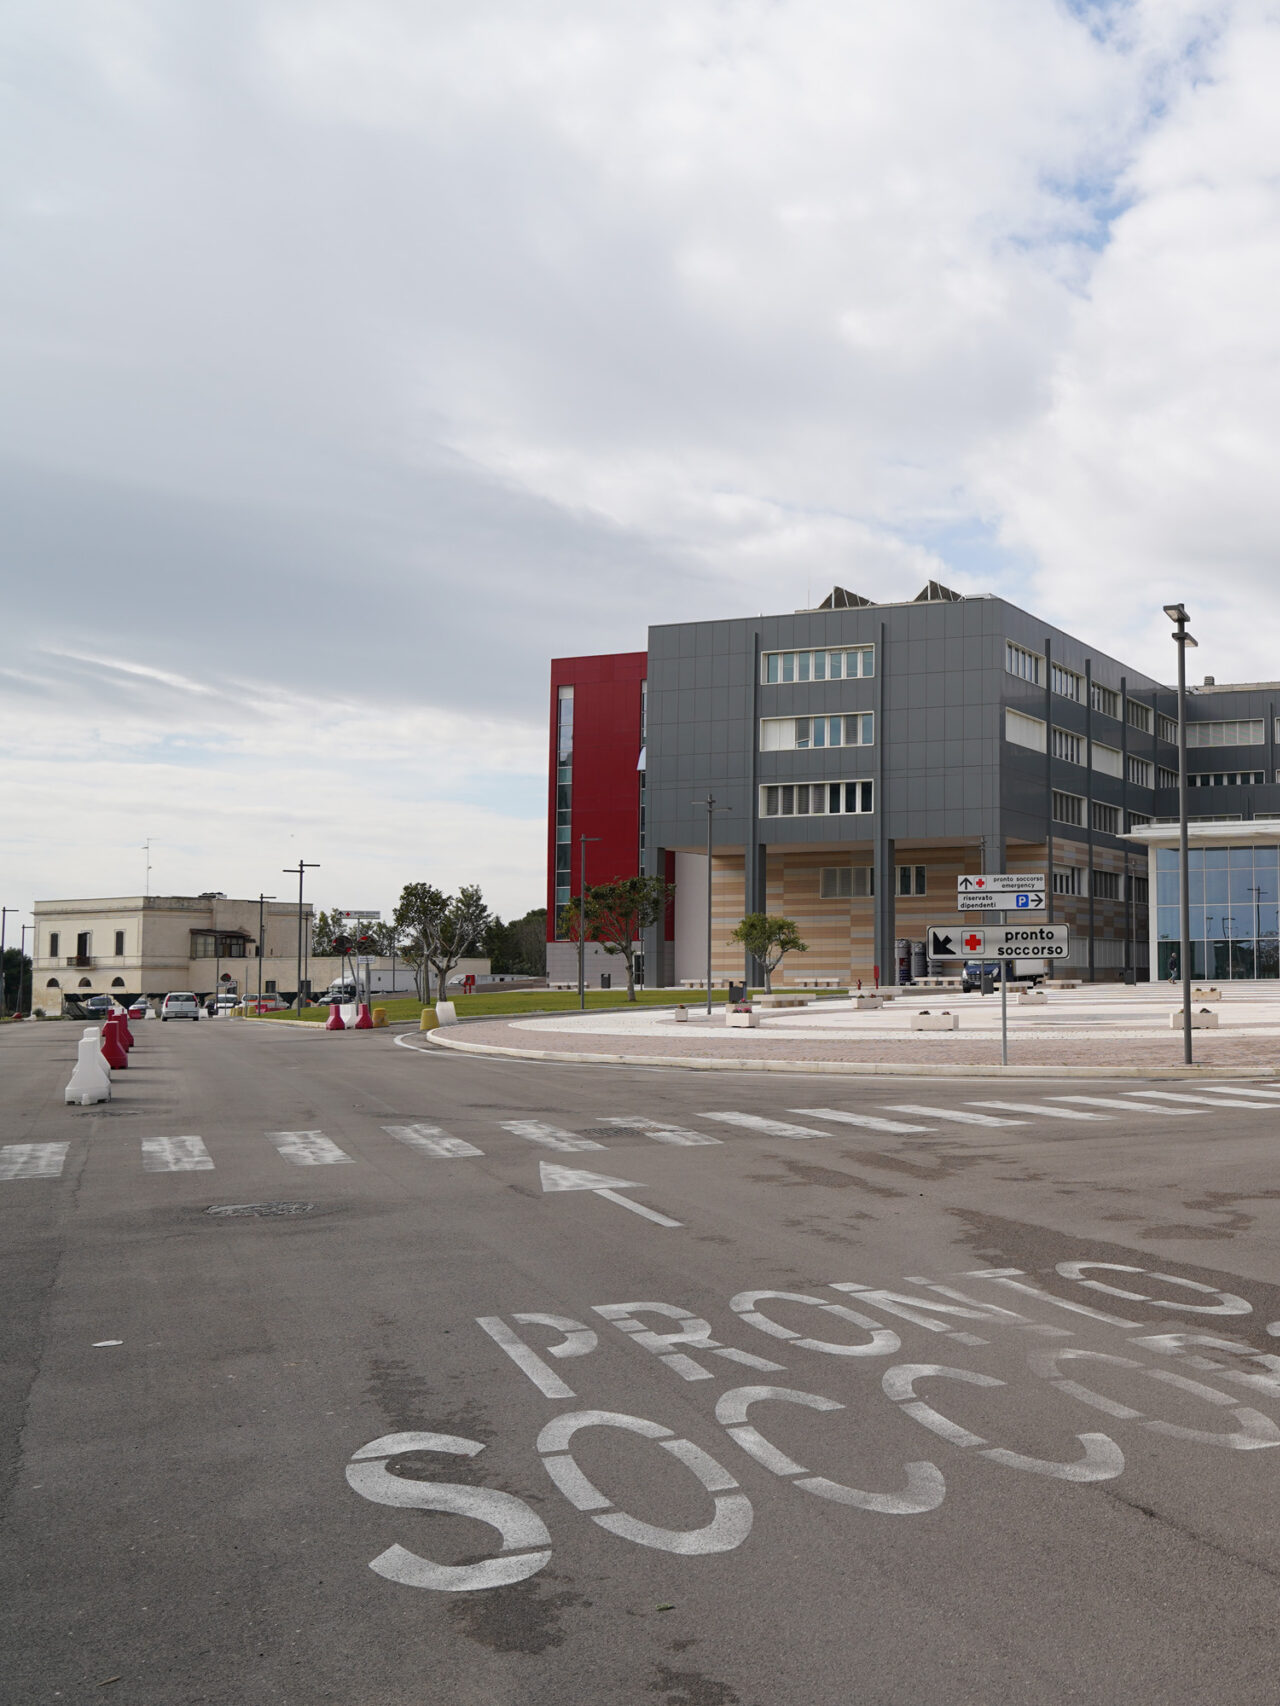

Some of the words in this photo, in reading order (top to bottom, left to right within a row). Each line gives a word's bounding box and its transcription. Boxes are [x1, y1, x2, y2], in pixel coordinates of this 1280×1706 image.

[1005, 928, 1054, 943] pronto
[997, 945, 1063, 956] soccorso
[474, 1259, 1255, 1400] PRONTO
